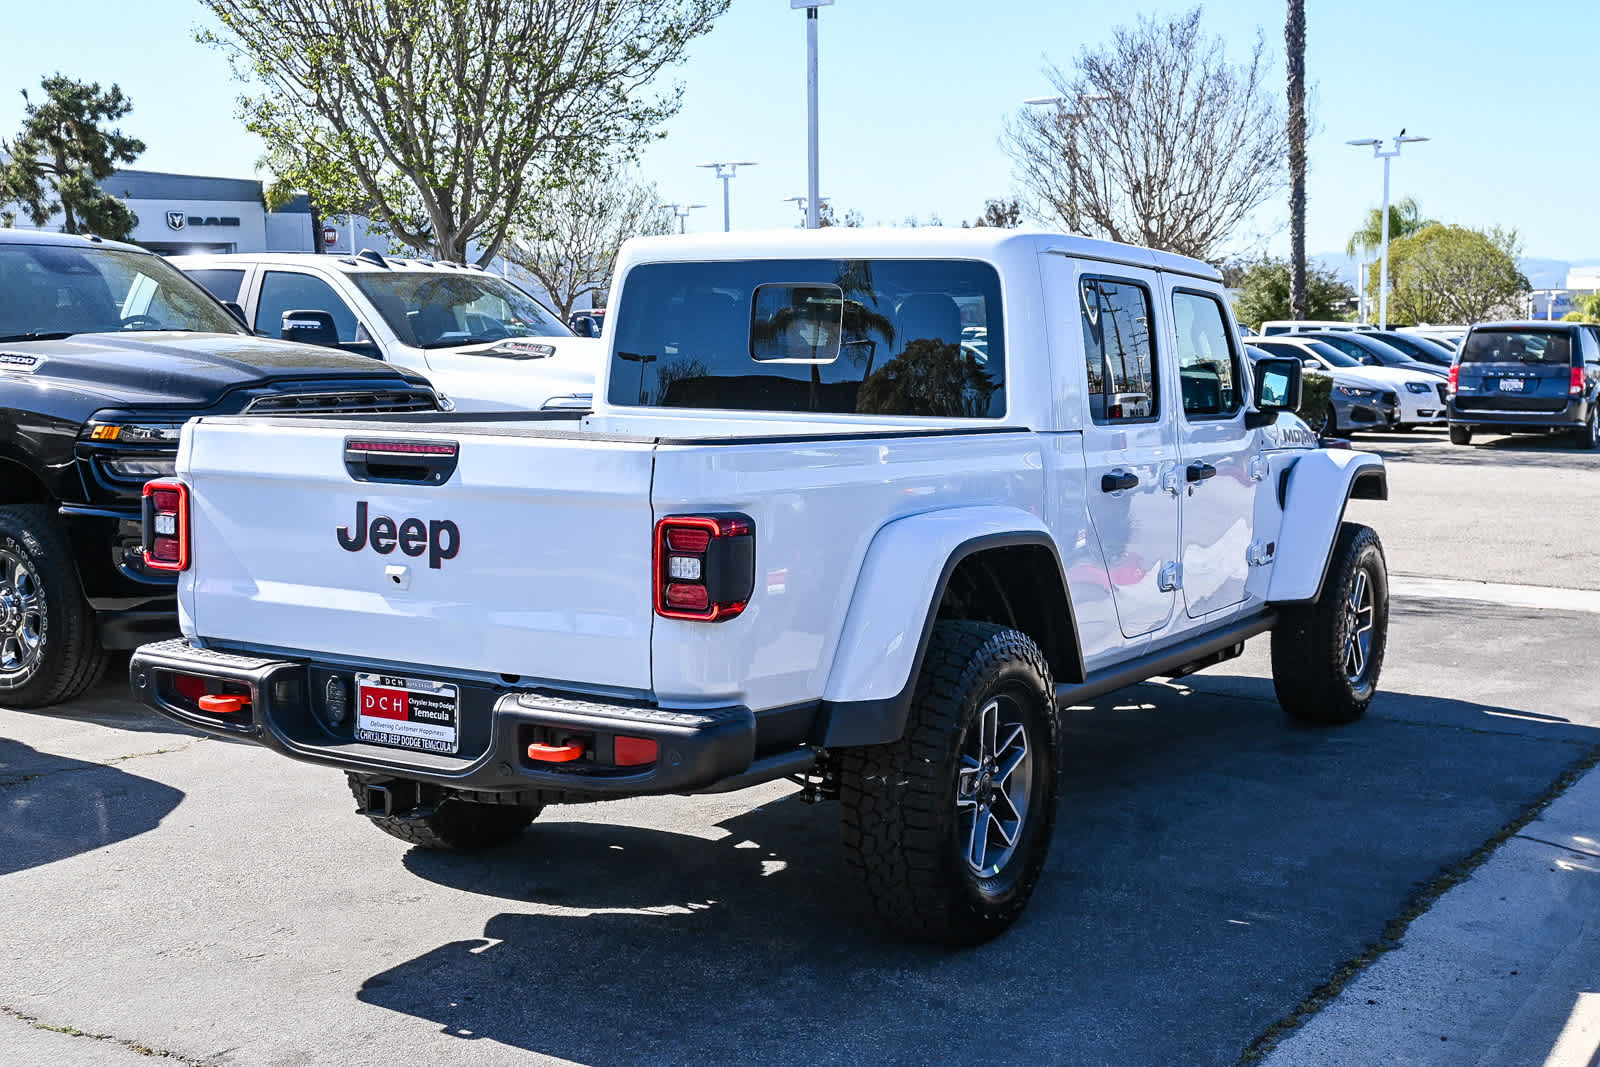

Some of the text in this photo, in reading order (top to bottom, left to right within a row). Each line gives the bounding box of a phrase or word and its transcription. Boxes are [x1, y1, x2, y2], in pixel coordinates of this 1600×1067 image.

[336, 501, 461, 569] Jeep
[366, 695, 402, 712] DCH
[408, 698, 455, 711] Chrysler Jeep Dodge
[413, 707, 449, 720] Temecula
[370, 720, 394, 731] Delivering
[395, 724, 418, 733] Customer
[360, 730, 451, 751] CHRYSLER JEEP DODGE TEMECULA
